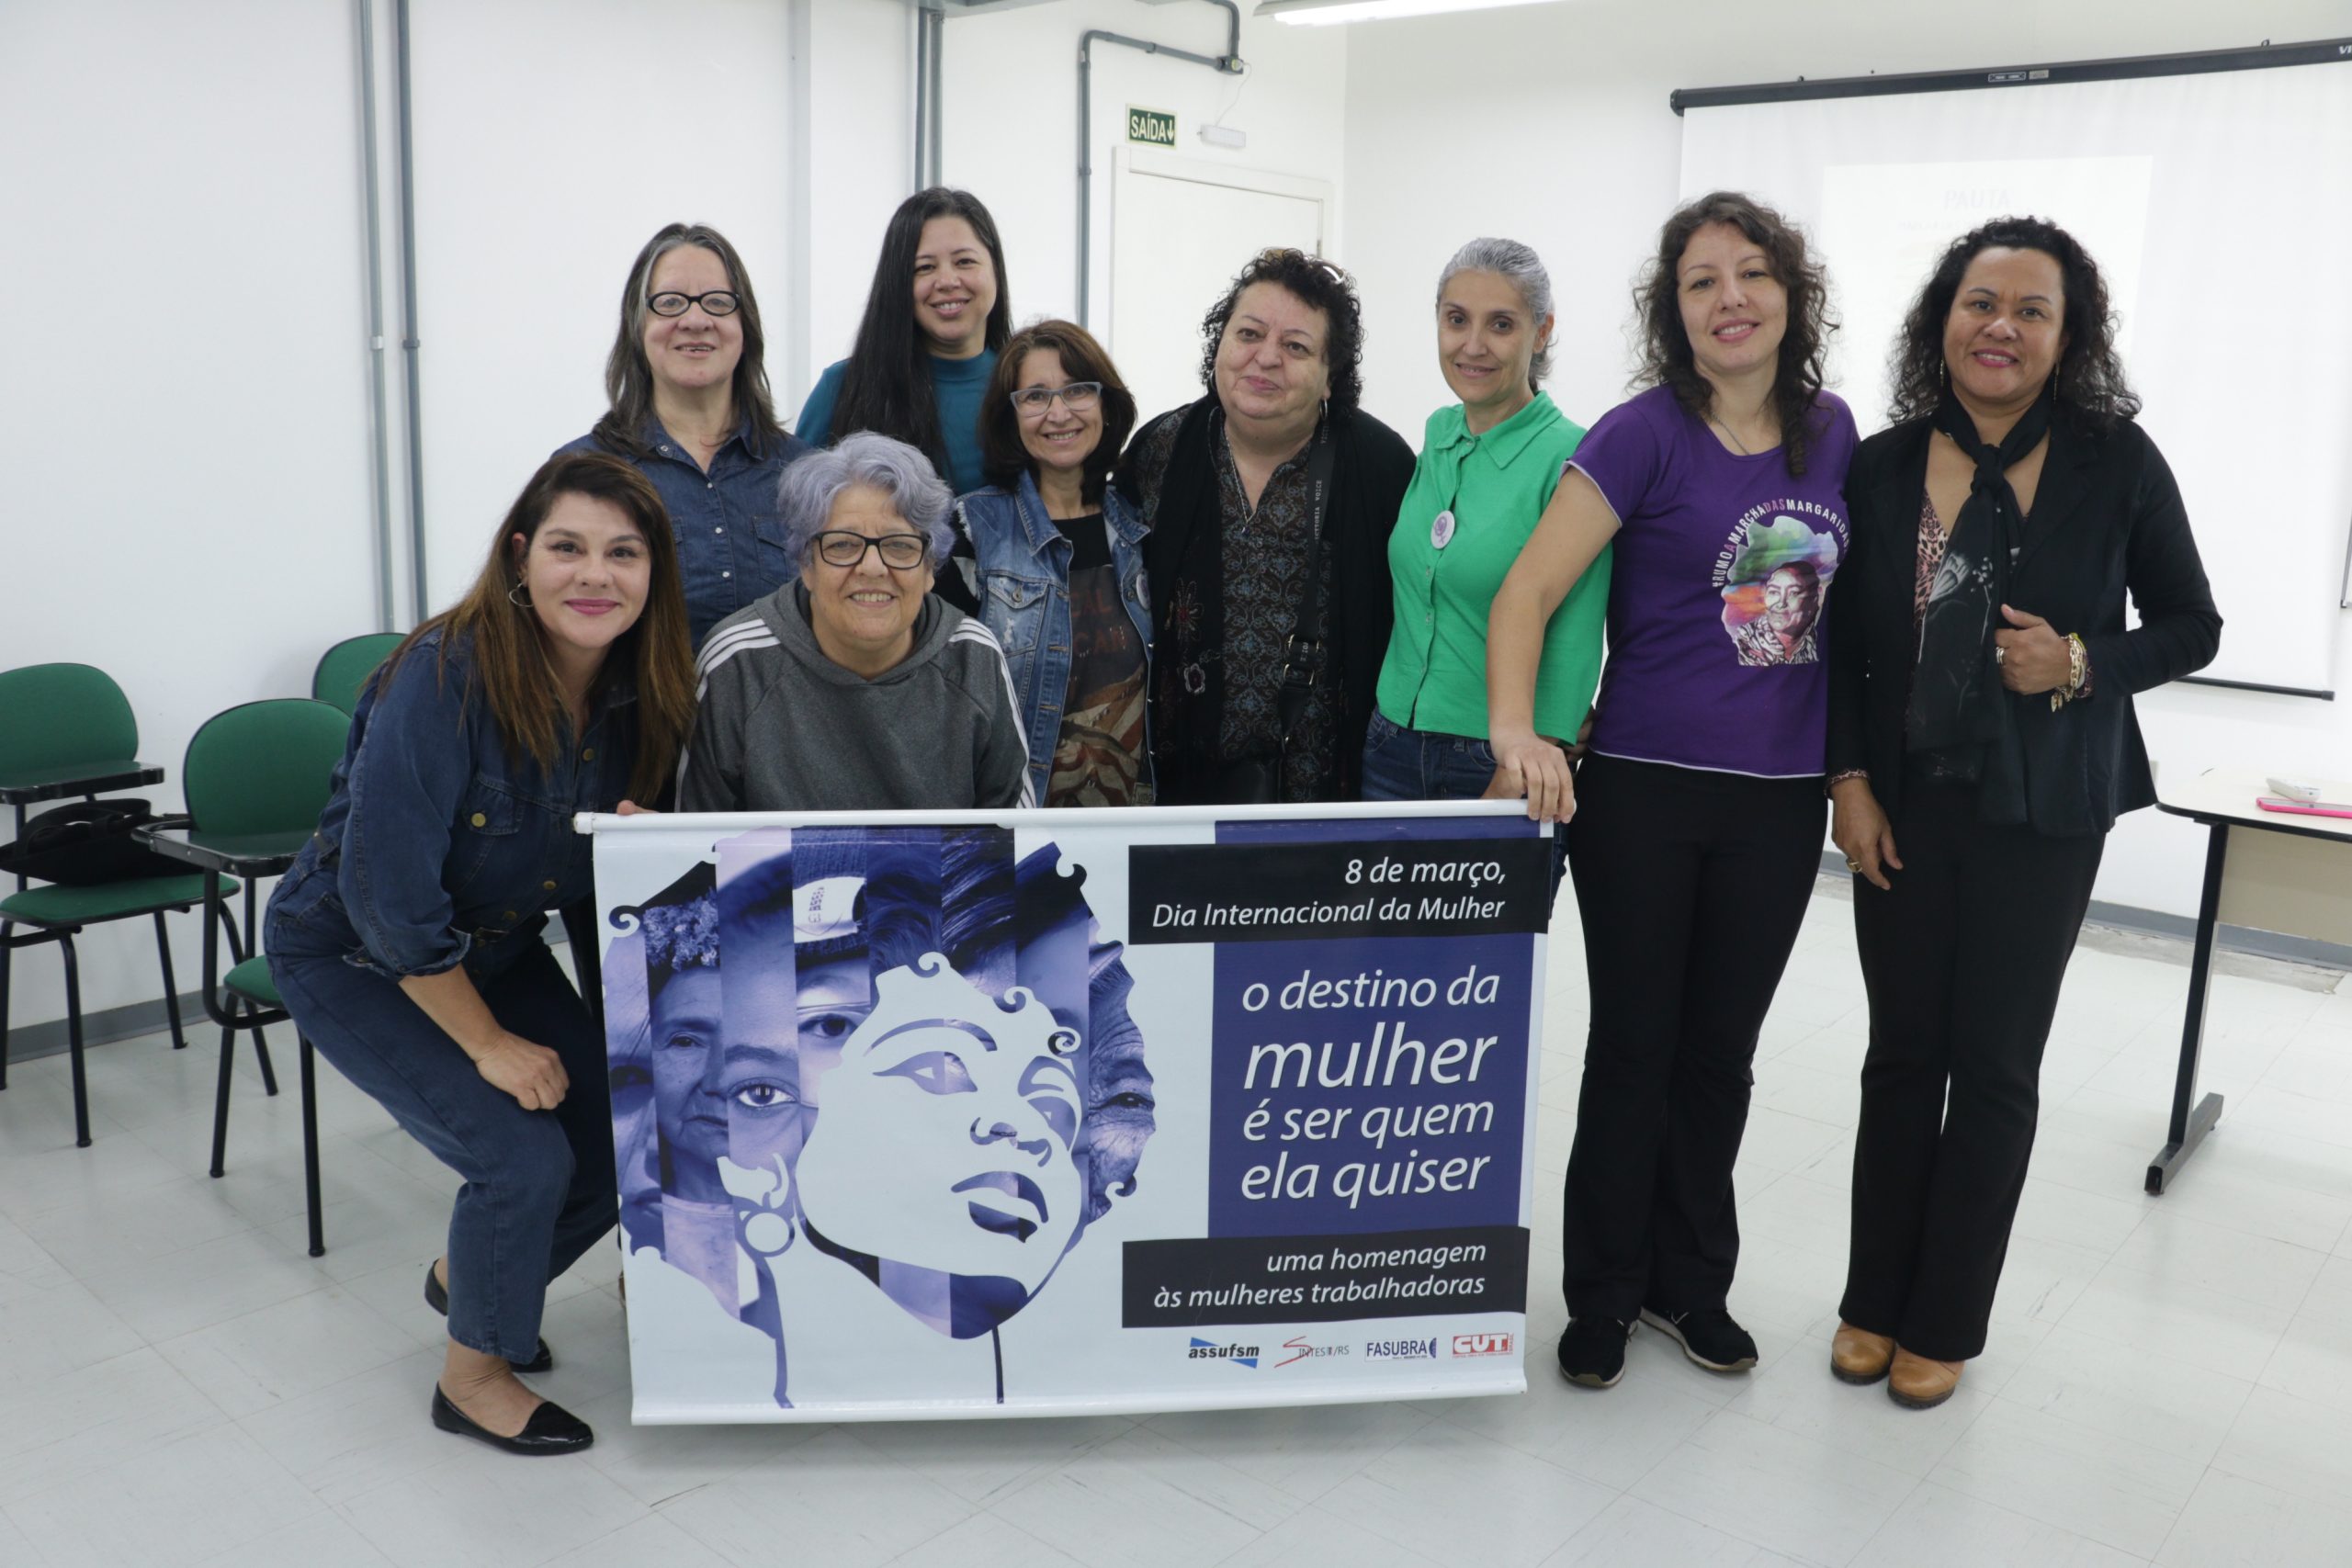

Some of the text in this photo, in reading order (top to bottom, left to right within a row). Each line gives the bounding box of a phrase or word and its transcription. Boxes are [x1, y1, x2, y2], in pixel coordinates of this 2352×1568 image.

[1131, 113, 1167, 141] SAÍDA
[1345, 856, 1506, 888] 8 de março,
[1152, 896, 1506, 927] Dia Internacional da Mulher
[1242, 964, 1500, 1011] o destino da
[1243, 1021, 1498, 1089] mulher
[1243, 1098, 1494, 1149] é ser quem
[1241, 1149, 1491, 1209] ela quiser
[1267, 1245, 1487, 1272] uma homenagem
[1154, 1274, 1486, 1308] às mulheres trabalhadoras
[1189, 1343, 1260, 1359] assufsm
[1366, 1340, 1428, 1358] FASUBRA
[1453, 1334, 1508, 1353] CUT
